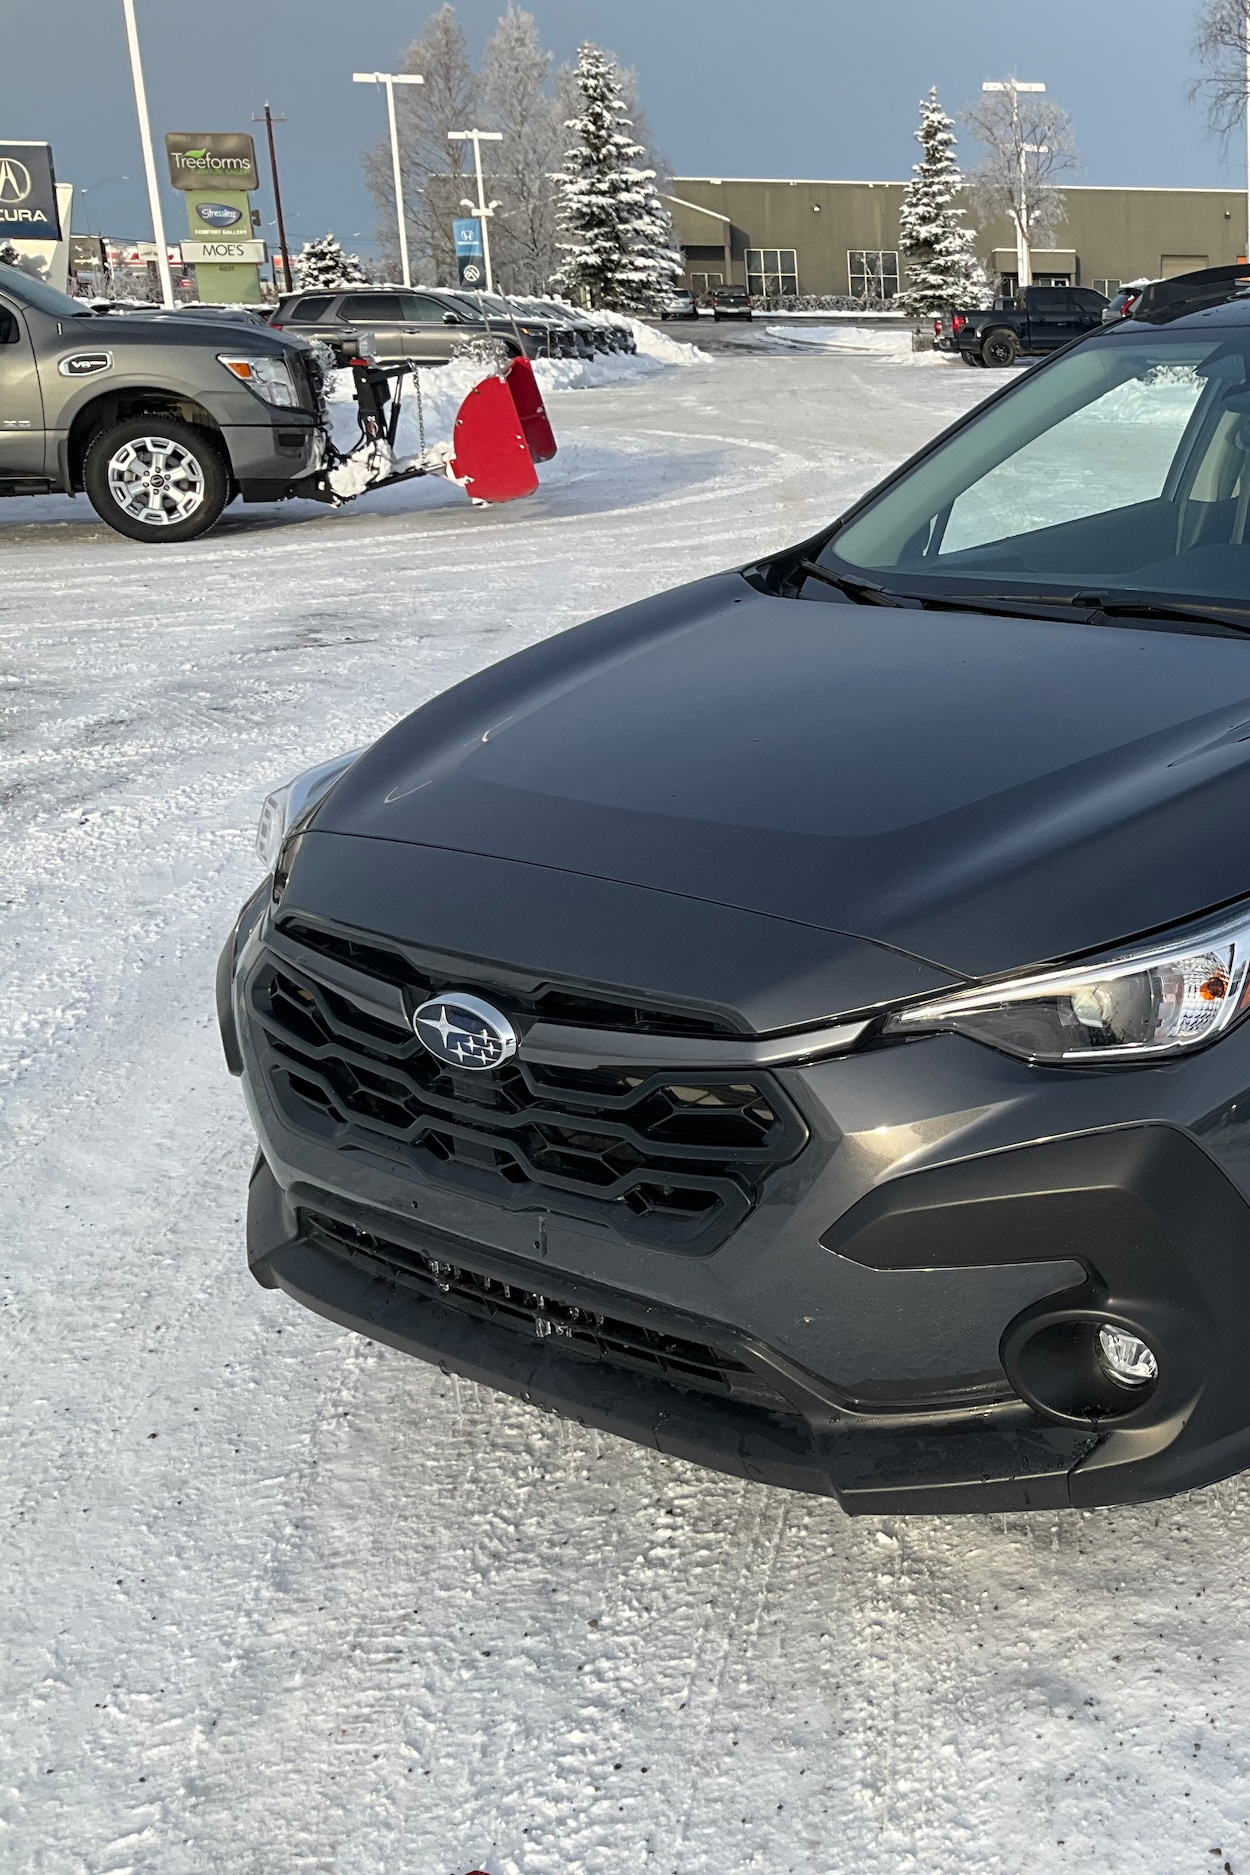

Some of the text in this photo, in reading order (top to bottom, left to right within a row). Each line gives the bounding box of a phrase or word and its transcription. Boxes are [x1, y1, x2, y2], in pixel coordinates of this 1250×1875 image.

[171, 152, 251, 169] Treeforms
[201, 209, 236, 218] Stressless
[203, 245, 244, 256] MOE'S
